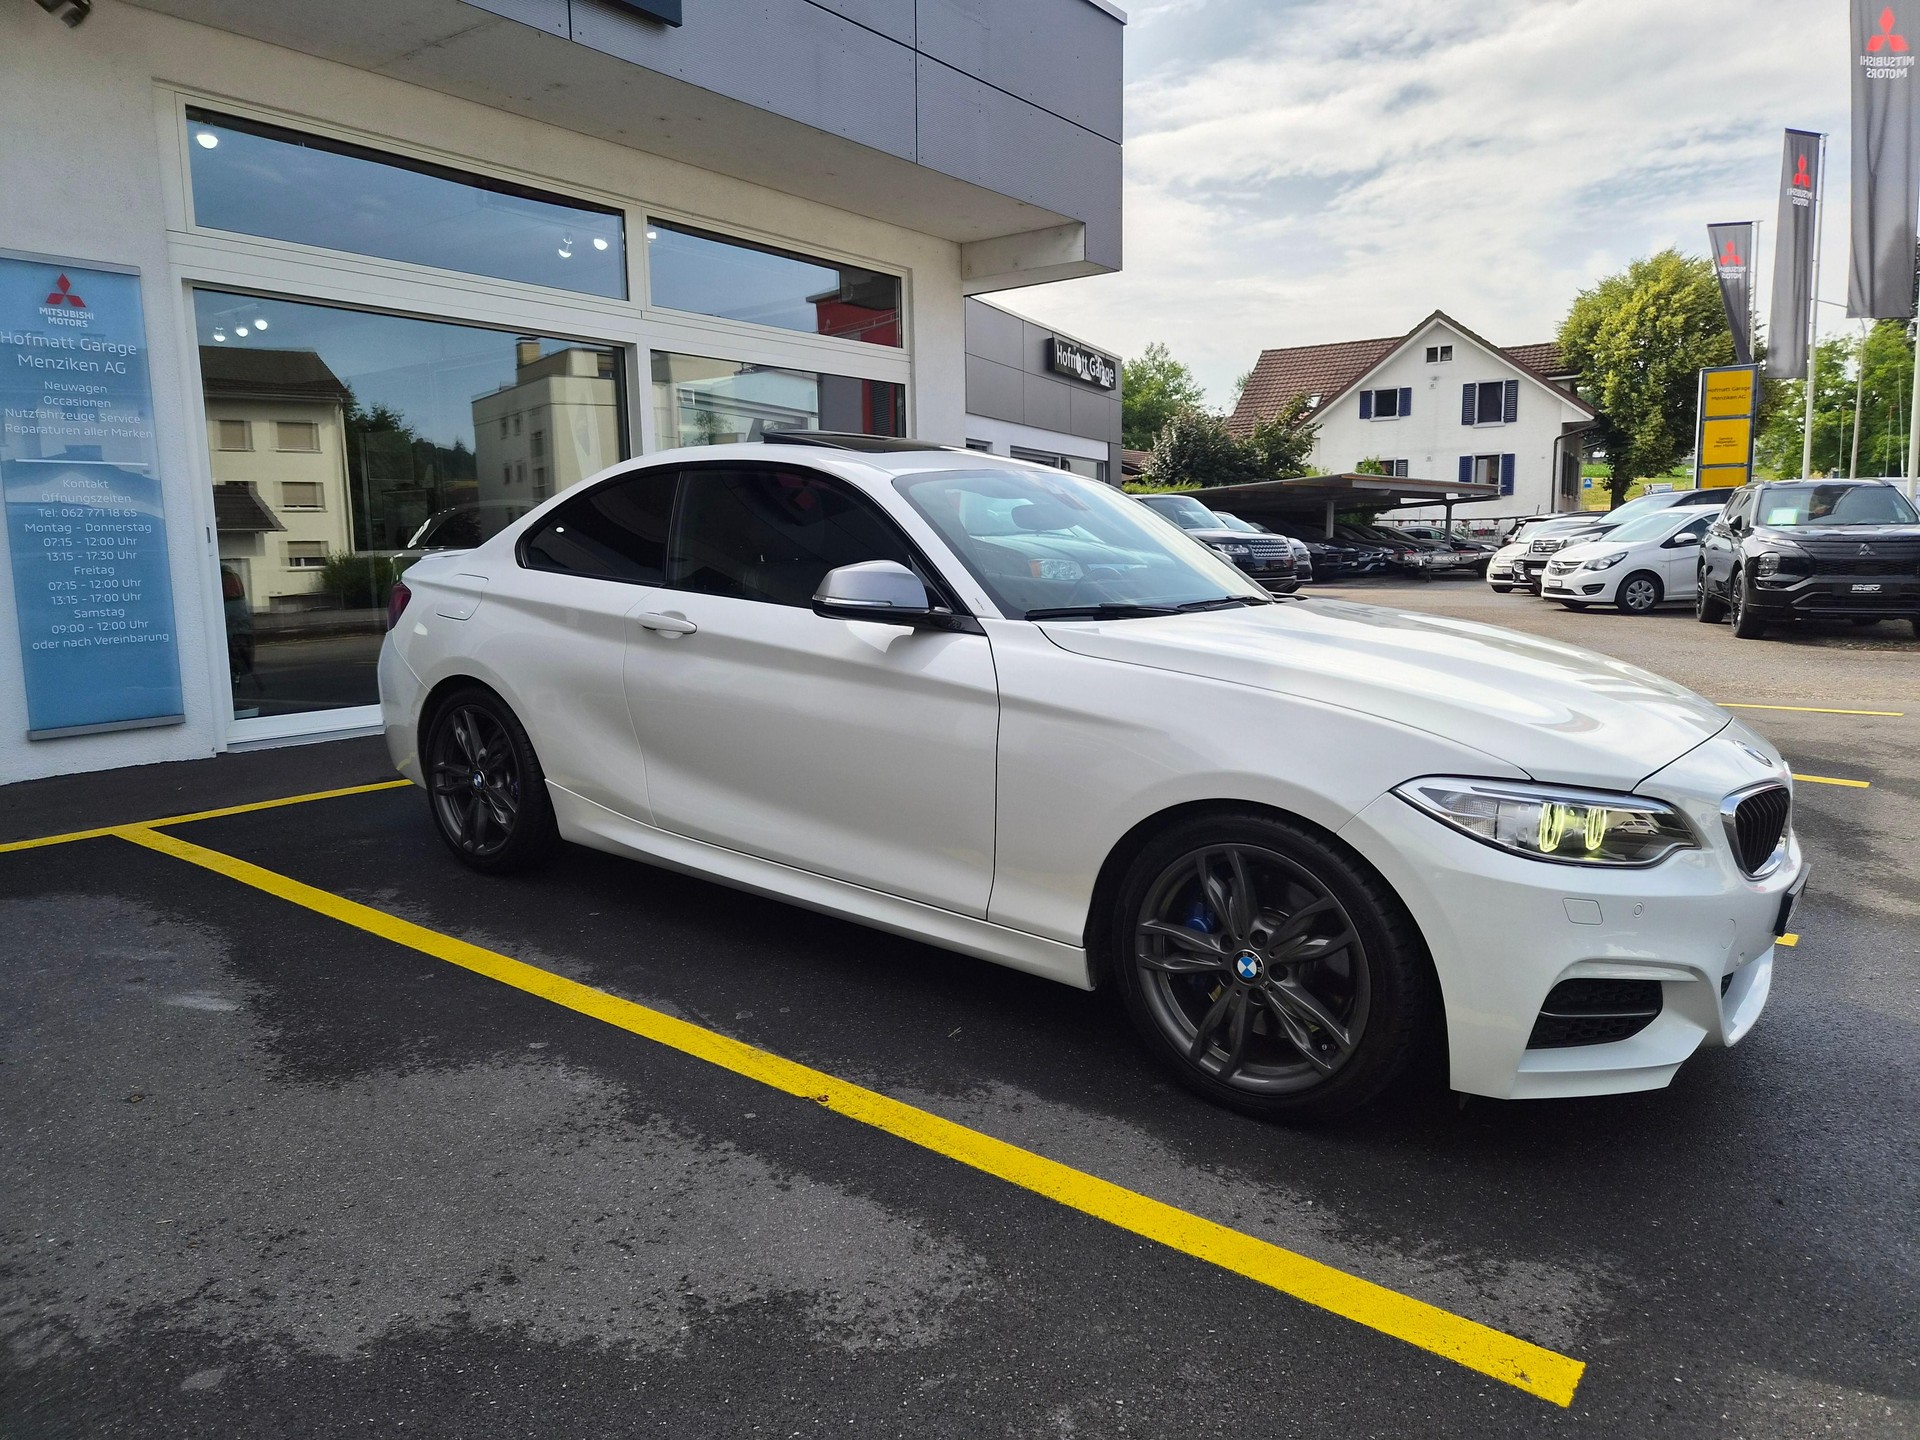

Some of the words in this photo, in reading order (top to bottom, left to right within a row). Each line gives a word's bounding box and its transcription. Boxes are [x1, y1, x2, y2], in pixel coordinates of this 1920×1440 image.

[39, 307, 94, 320] MITSUBISHI
[47, 317, 88, 328] MOTORS
[0, 331, 75, 350] Hofmatt
[80, 338, 137, 356] Garage
[17, 354, 99, 372] Menziken
[104, 361, 126, 375] AG
[44, 381, 108, 395] Neuwagen
[43, 395, 111, 408] Occasionen
[5, 408, 95, 422] Nutzfahrzeuge
[99, 413, 141, 424] Service
[4, 423, 80, 435] Reparaturen
[84, 427, 108, 437] aller
[111, 428, 153, 439] Marken
[62, 479, 109, 489] Kontakt
[41, 492, 132, 503] Öffnungszeiten
[37, 508, 58, 518] Tel:
[61, 508, 84, 518] 062
[87, 508, 106, 518] 771
[109, 508, 120, 518] 18
[123, 508, 137, 518] 65
[25, 523, 72, 534] Montag
[85, 523, 152, 533] Donnerstag
[43, 537, 73, 547] 07:15
[85, 537, 115, 546] 12:00
[117, 536, 138, 546] Uhr
[46, 551, 74, 561] 13:15
[86, 551, 114, 560] 17:30
[117, 550, 137, 560] Uhr
[74, 566, 115, 576] Freitag
[48, 581, 77, 591] 07:15
[89, 579, 119, 589] 12:00
[122, 578, 142, 588] Uhr
[51, 595, 78, 605] 13:15
[90, 593, 119, 603] 17:00
[122, 592, 142, 602] Uhr
[74, 608, 125, 619] Samstag
[51, 623, 85, 634] 09:00
[97, 621, 126, 631] 12:00
[129, 620, 149, 630] Uhr
[32, 640, 60, 650] oder
[63, 636, 92, 648] nach
[94, 633, 169, 645] Vereinbarung
